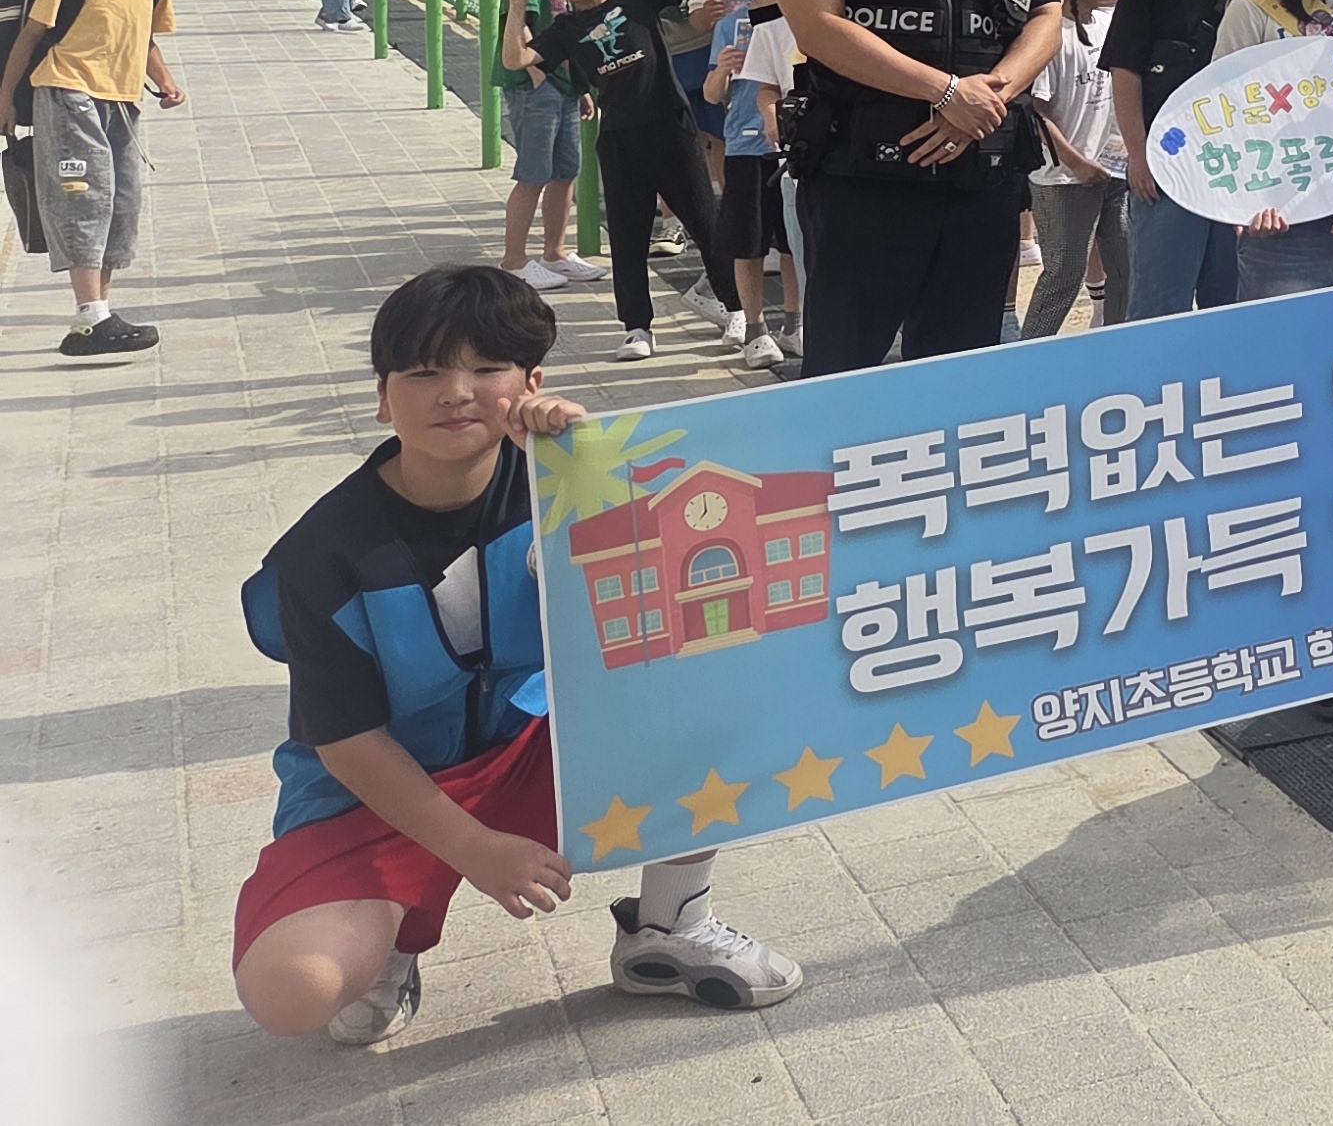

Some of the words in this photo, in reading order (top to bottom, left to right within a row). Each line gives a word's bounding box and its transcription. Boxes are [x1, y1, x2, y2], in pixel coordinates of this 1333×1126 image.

[60, 162, 84, 172] USA
[827, 377, 1303, 538] 폭력없는
[836, 497, 1308, 694] 행복가득
[1031, 637, 1302, 740] 양지초등학교
